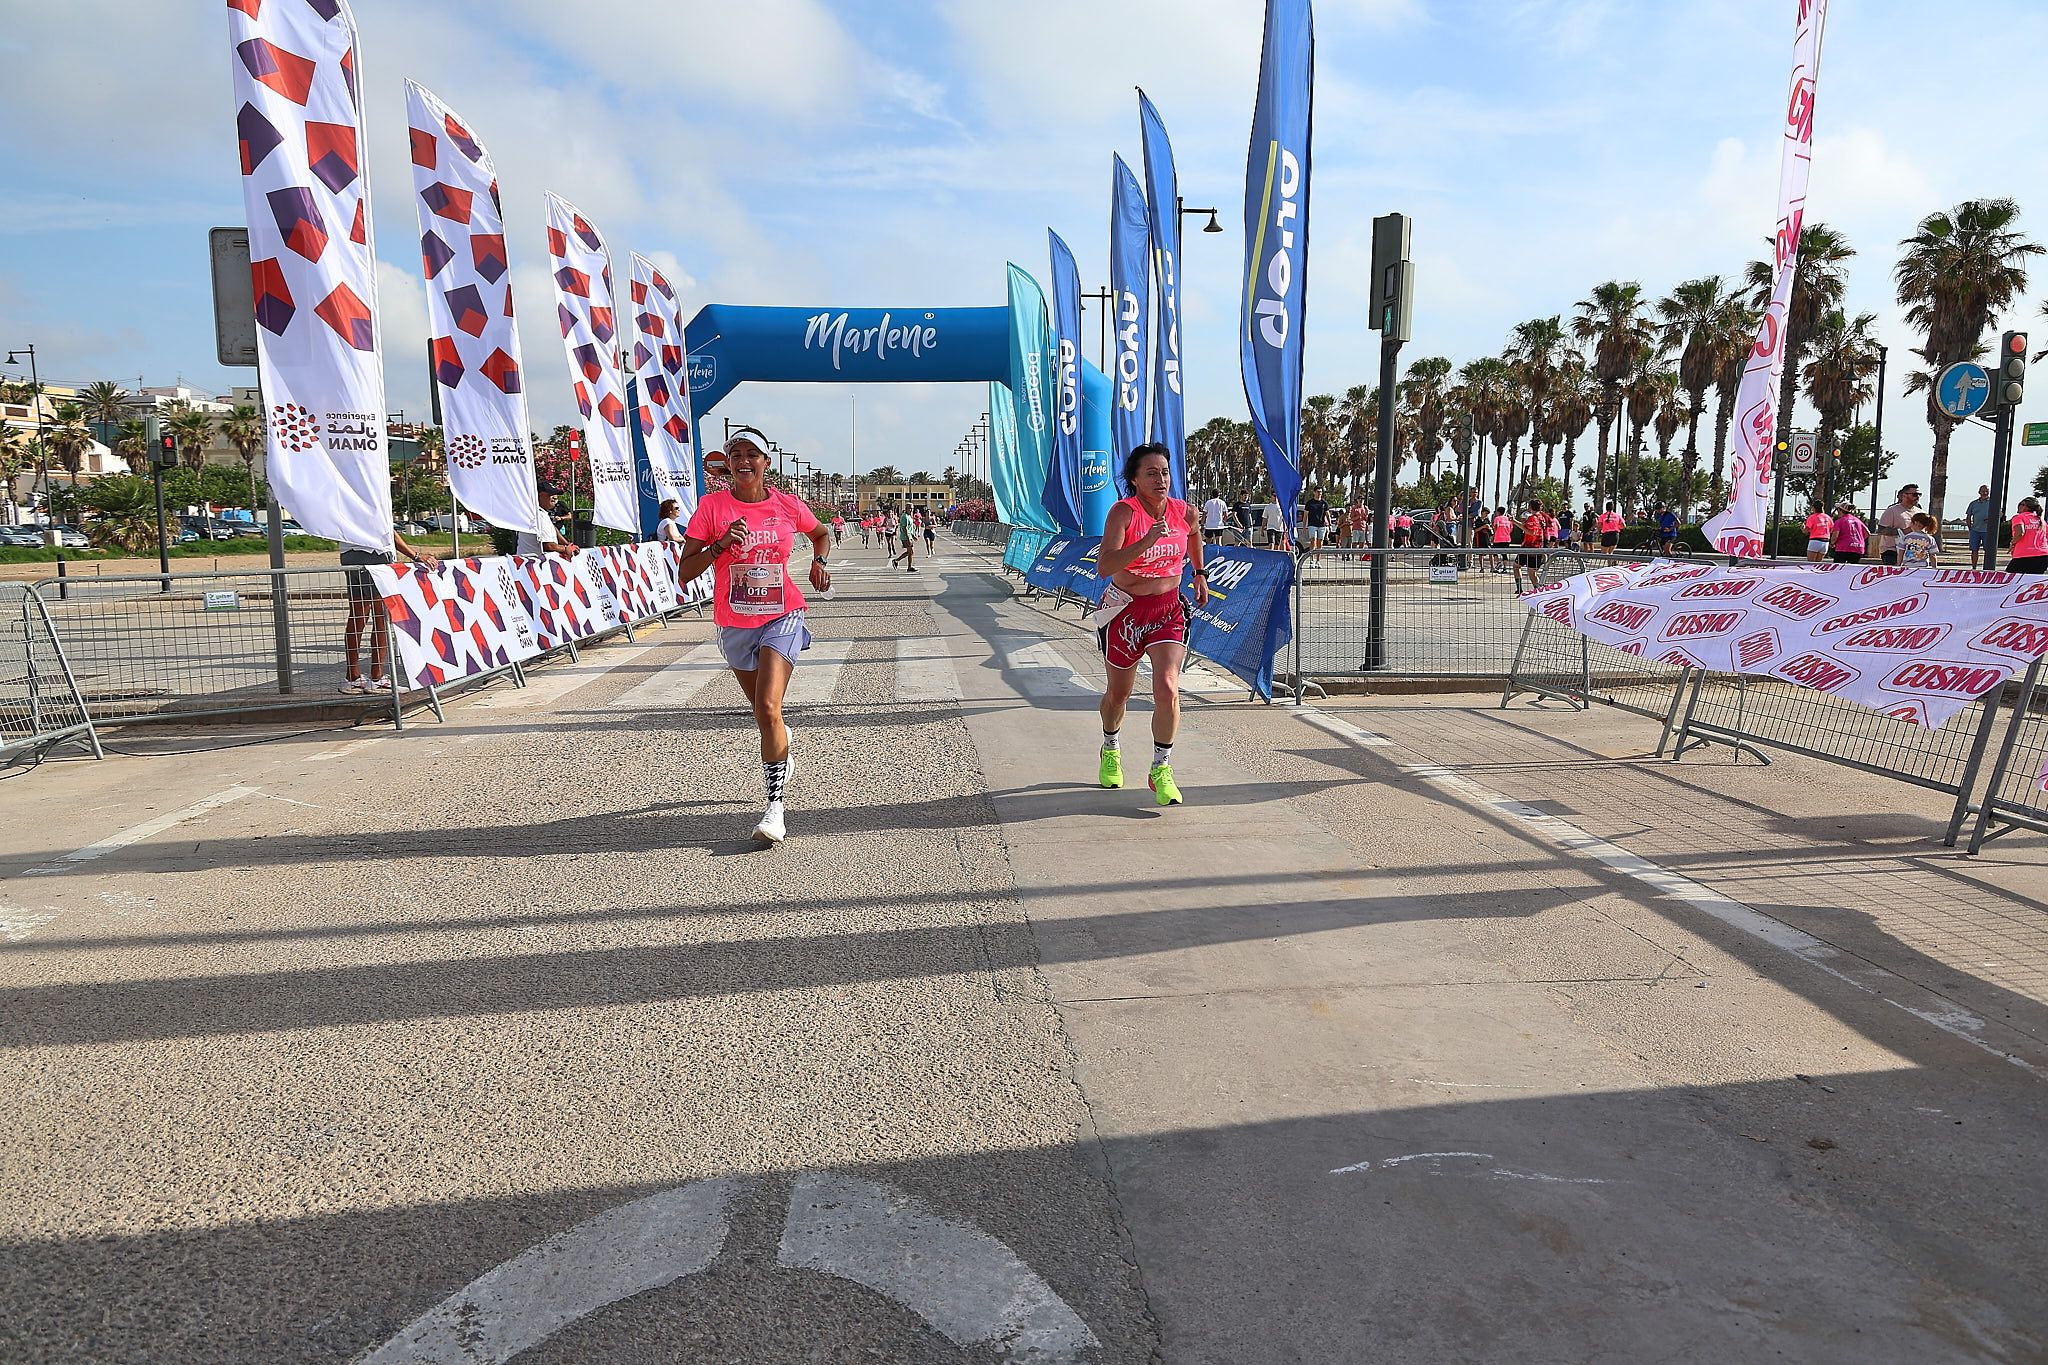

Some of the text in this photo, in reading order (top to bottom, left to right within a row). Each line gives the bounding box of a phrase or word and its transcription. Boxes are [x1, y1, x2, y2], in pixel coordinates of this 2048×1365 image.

[804, 312, 937, 370] Marlene
[1798, 449, 1809, 457] 30
[1638, 566, 1710, 588] COSMO
[1681, 579, 1756, 597] COSMO
[747, 587, 768, 596] 016
[1762, 586, 1831, 617] COSMO
[1594, 602, 1652, 630] COSMO
[1666, 612, 1739, 638] COSMO
[1822, 597, 1919, 632] COSMO
[1846, 627, 1941, 650] COSMO
[1779, 654, 1852, 692] COSMO
[1893, 663, 2001, 695] COSMO
